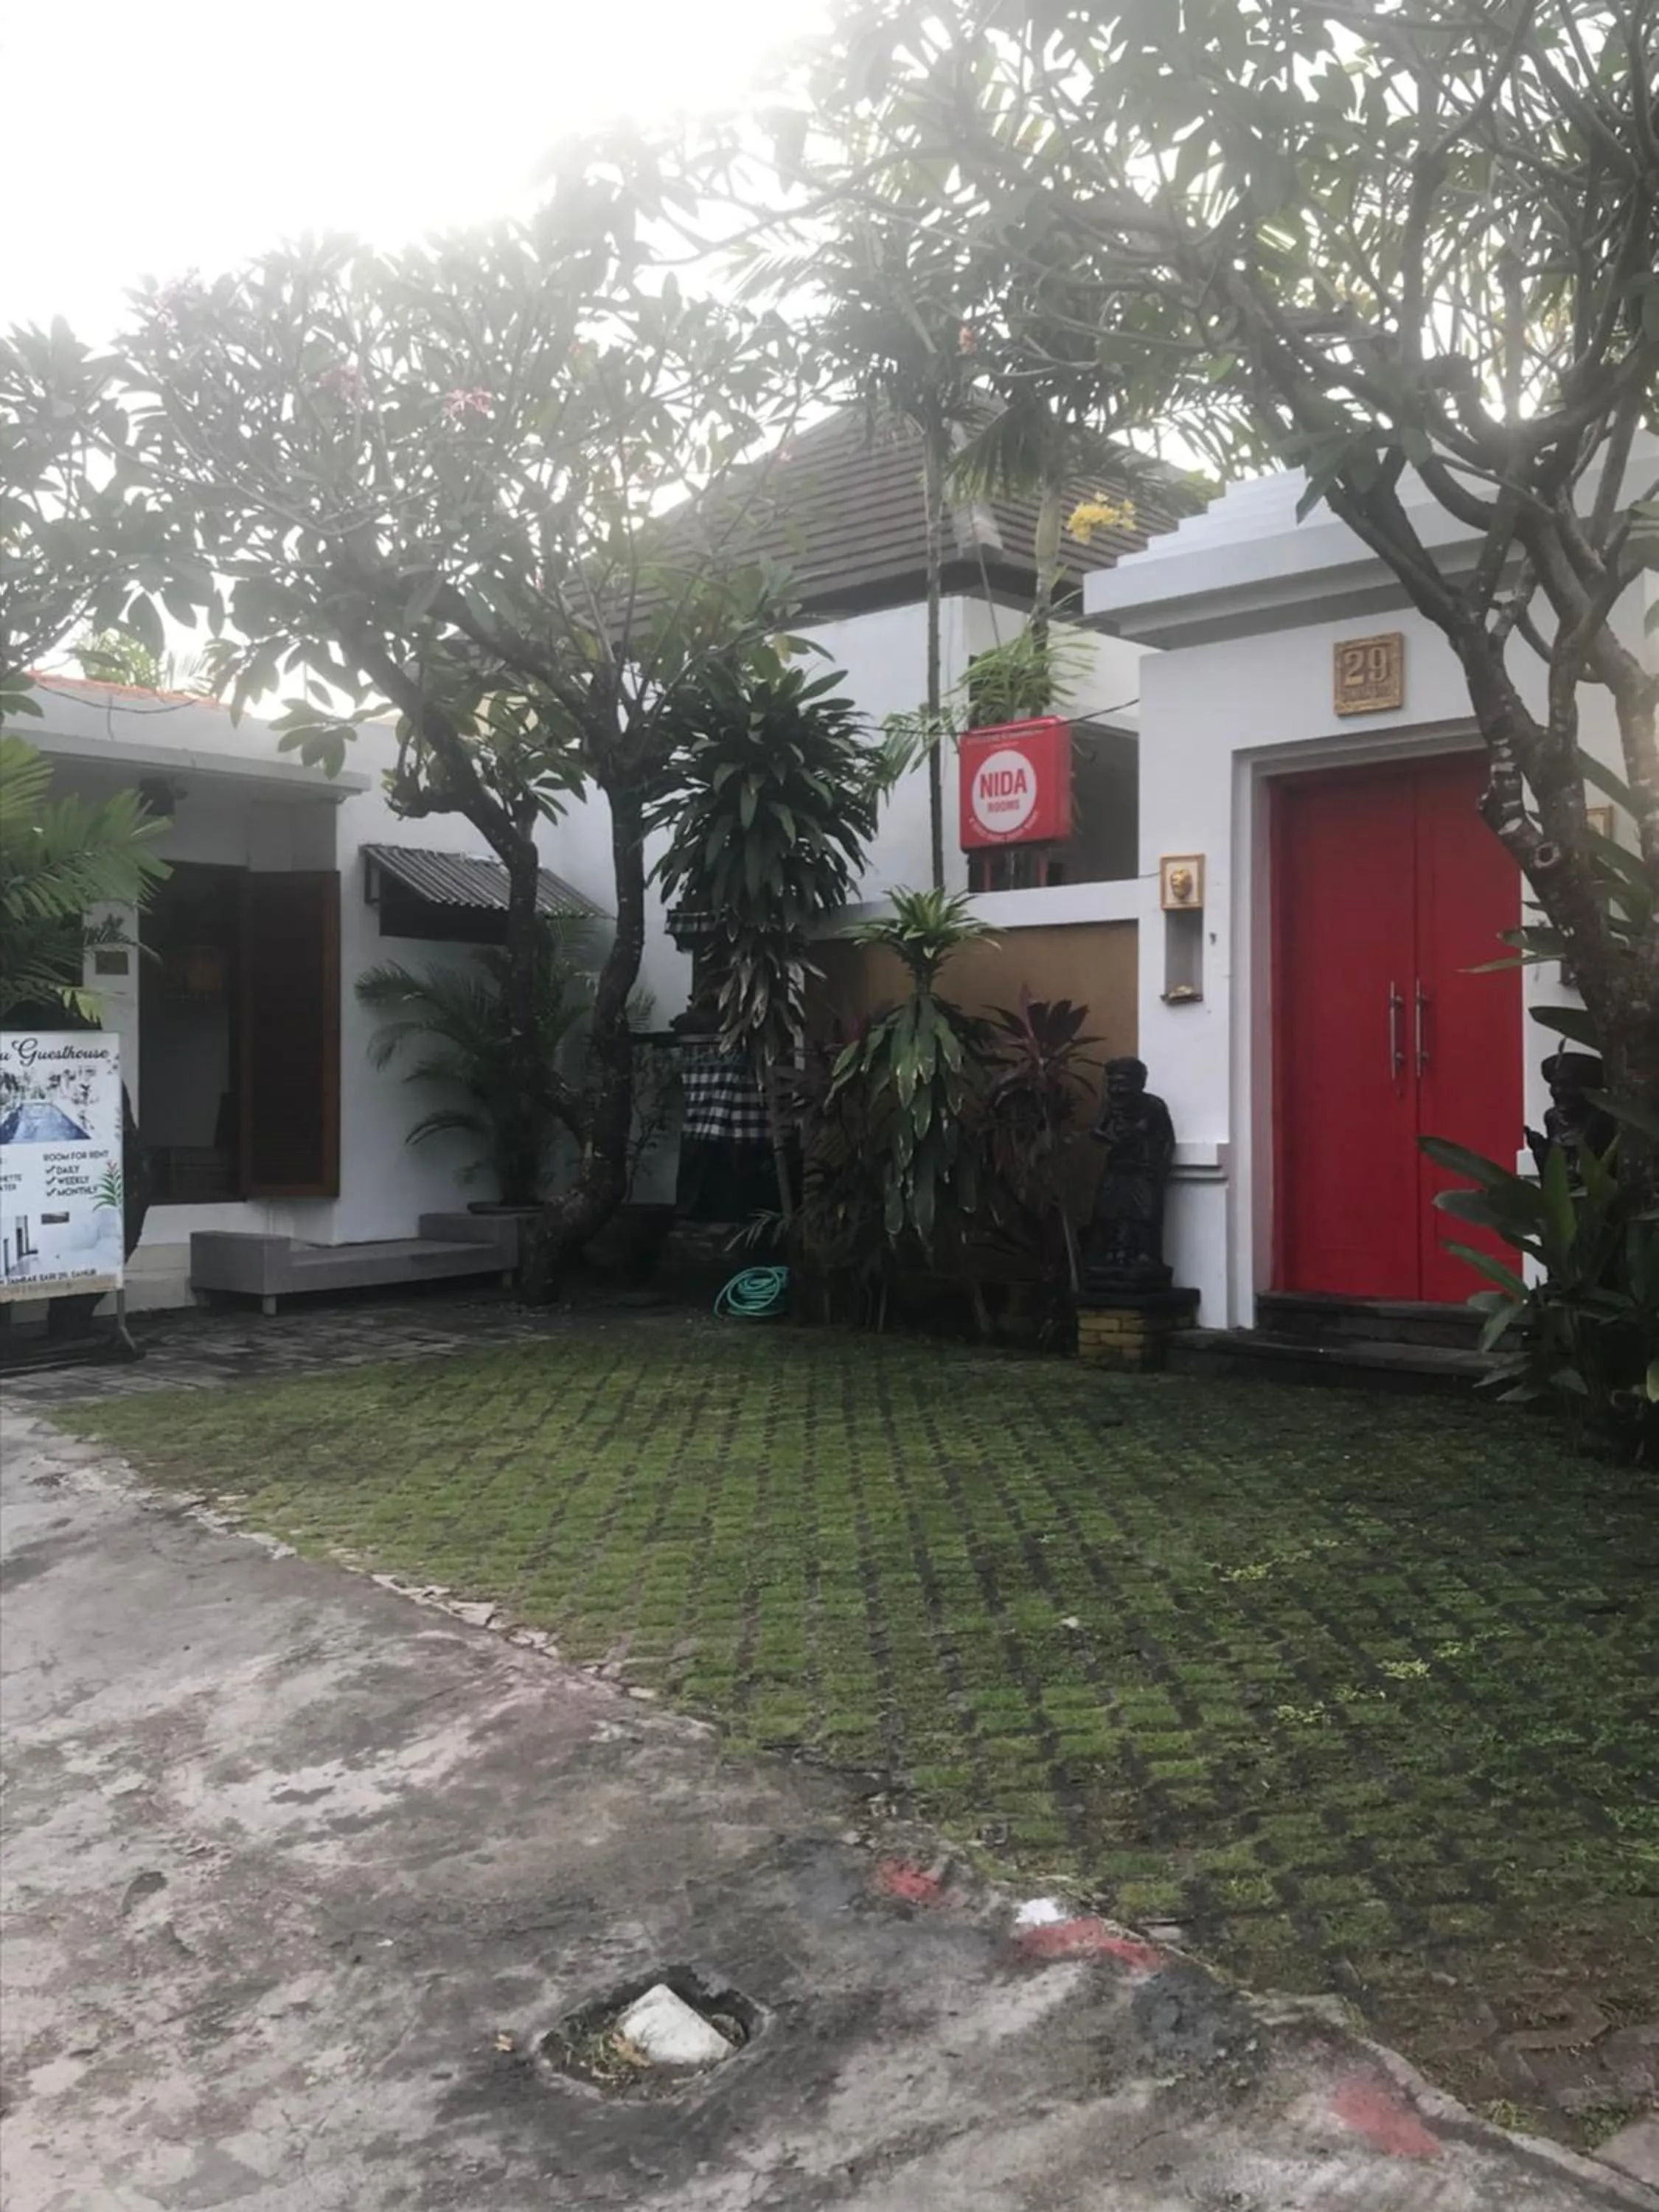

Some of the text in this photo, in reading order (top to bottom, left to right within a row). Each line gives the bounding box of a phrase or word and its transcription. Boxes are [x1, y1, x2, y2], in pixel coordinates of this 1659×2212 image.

[1342, 647, 1388, 686] 29
[979, 768, 1027, 800] NIDA
[987, 799, 1020, 813] ROOMS
[11, 1037, 110, 1067] Guesthouse
[43, 1150, 108, 1161] ROOM FOR RENT
[56, 1165, 79, 1174] DAILY
[58, 1176, 89, 1185] WEEKLY
[58, 1185, 97, 1195] MONTHLY
